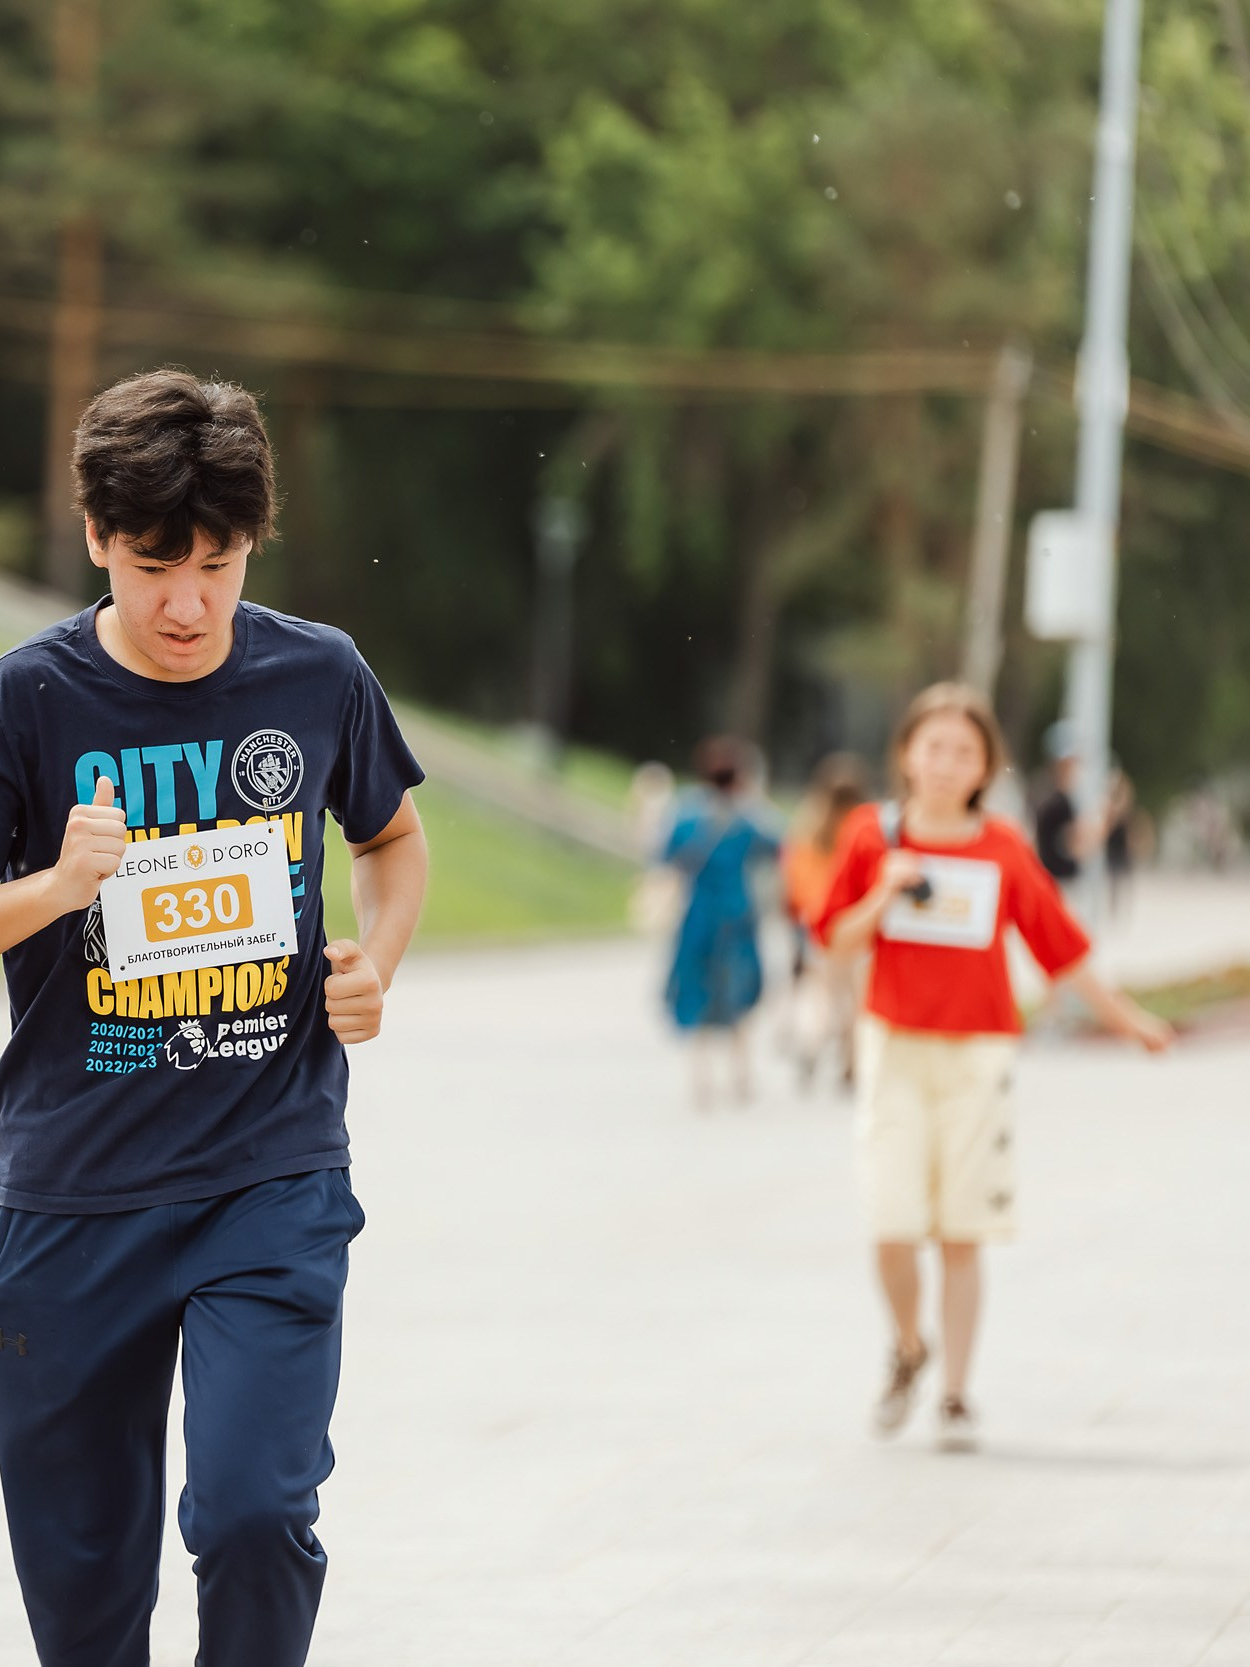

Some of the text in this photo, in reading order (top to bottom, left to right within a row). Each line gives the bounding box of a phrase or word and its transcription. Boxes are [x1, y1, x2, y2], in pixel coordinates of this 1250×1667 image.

[239, 735, 297, 763] MANCHESTER
[75, 739, 224, 827] CITY
[115, 854, 179, 878] LEONE
[153, 883, 241, 934] 330
[127, 932, 278, 965] БЛАГОТВОРИТЕЛЬНЫЙ ЗАБЕГ
[86, 954, 291, 1020] CHAMPIONS
[90, 1022, 164, 1040] 2020/2021
